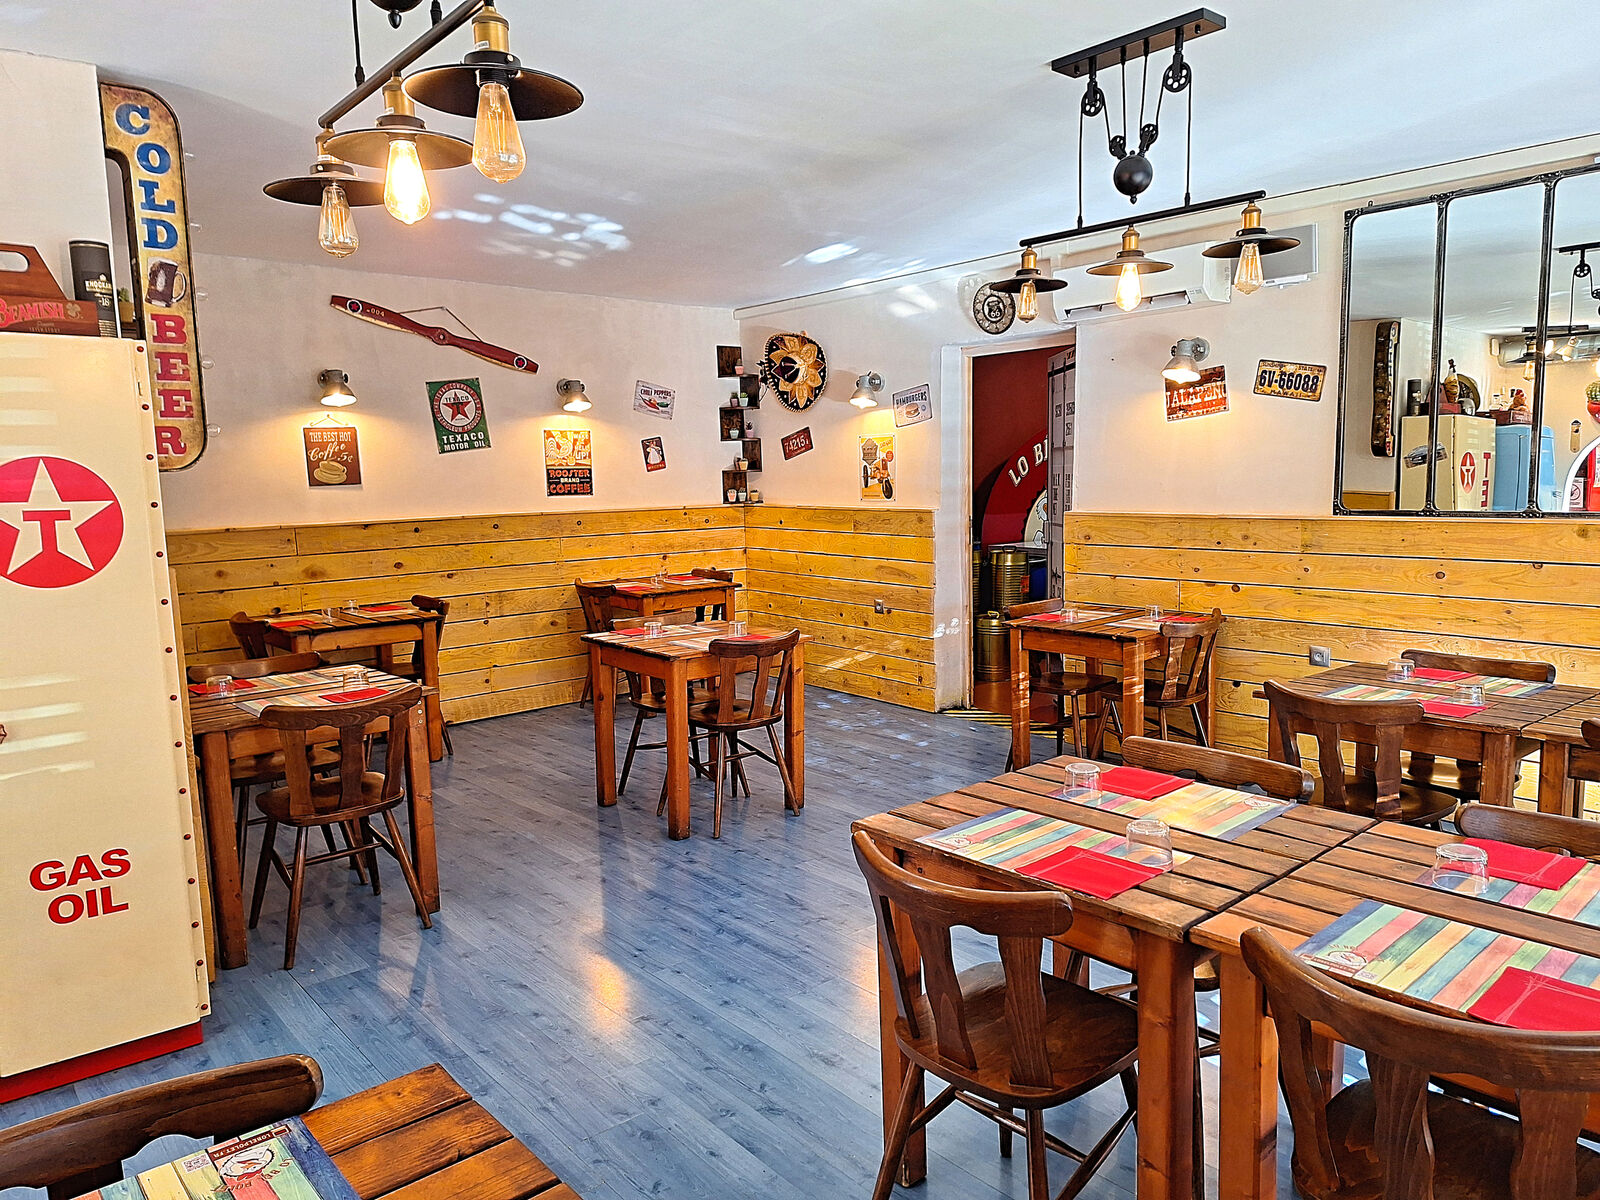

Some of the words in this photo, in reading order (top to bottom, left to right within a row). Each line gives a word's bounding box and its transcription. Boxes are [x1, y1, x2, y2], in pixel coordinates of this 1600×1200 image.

[115, 103, 179, 251] COLD
[150, 313, 194, 458] BEER
[1260, 369, 1320, 394] 6V-66088
[309, 431, 322, 442] THE
[323, 431, 338, 442] BEST
[339, 431, 351, 442] HOT
[442, 431, 485, 444] TEXACO
[444, 442, 469, 452] MOTOR
[474, 440, 486, 448] OIL
[308, 441, 346, 462] Coffee
[549, 470, 590, 478] ROOSTER
[1008, 455, 1029, 487] LO
[550, 483, 590, 493] COFFEE
[29, 848, 131, 891] GAS
[48, 885, 129, 925] OIL
